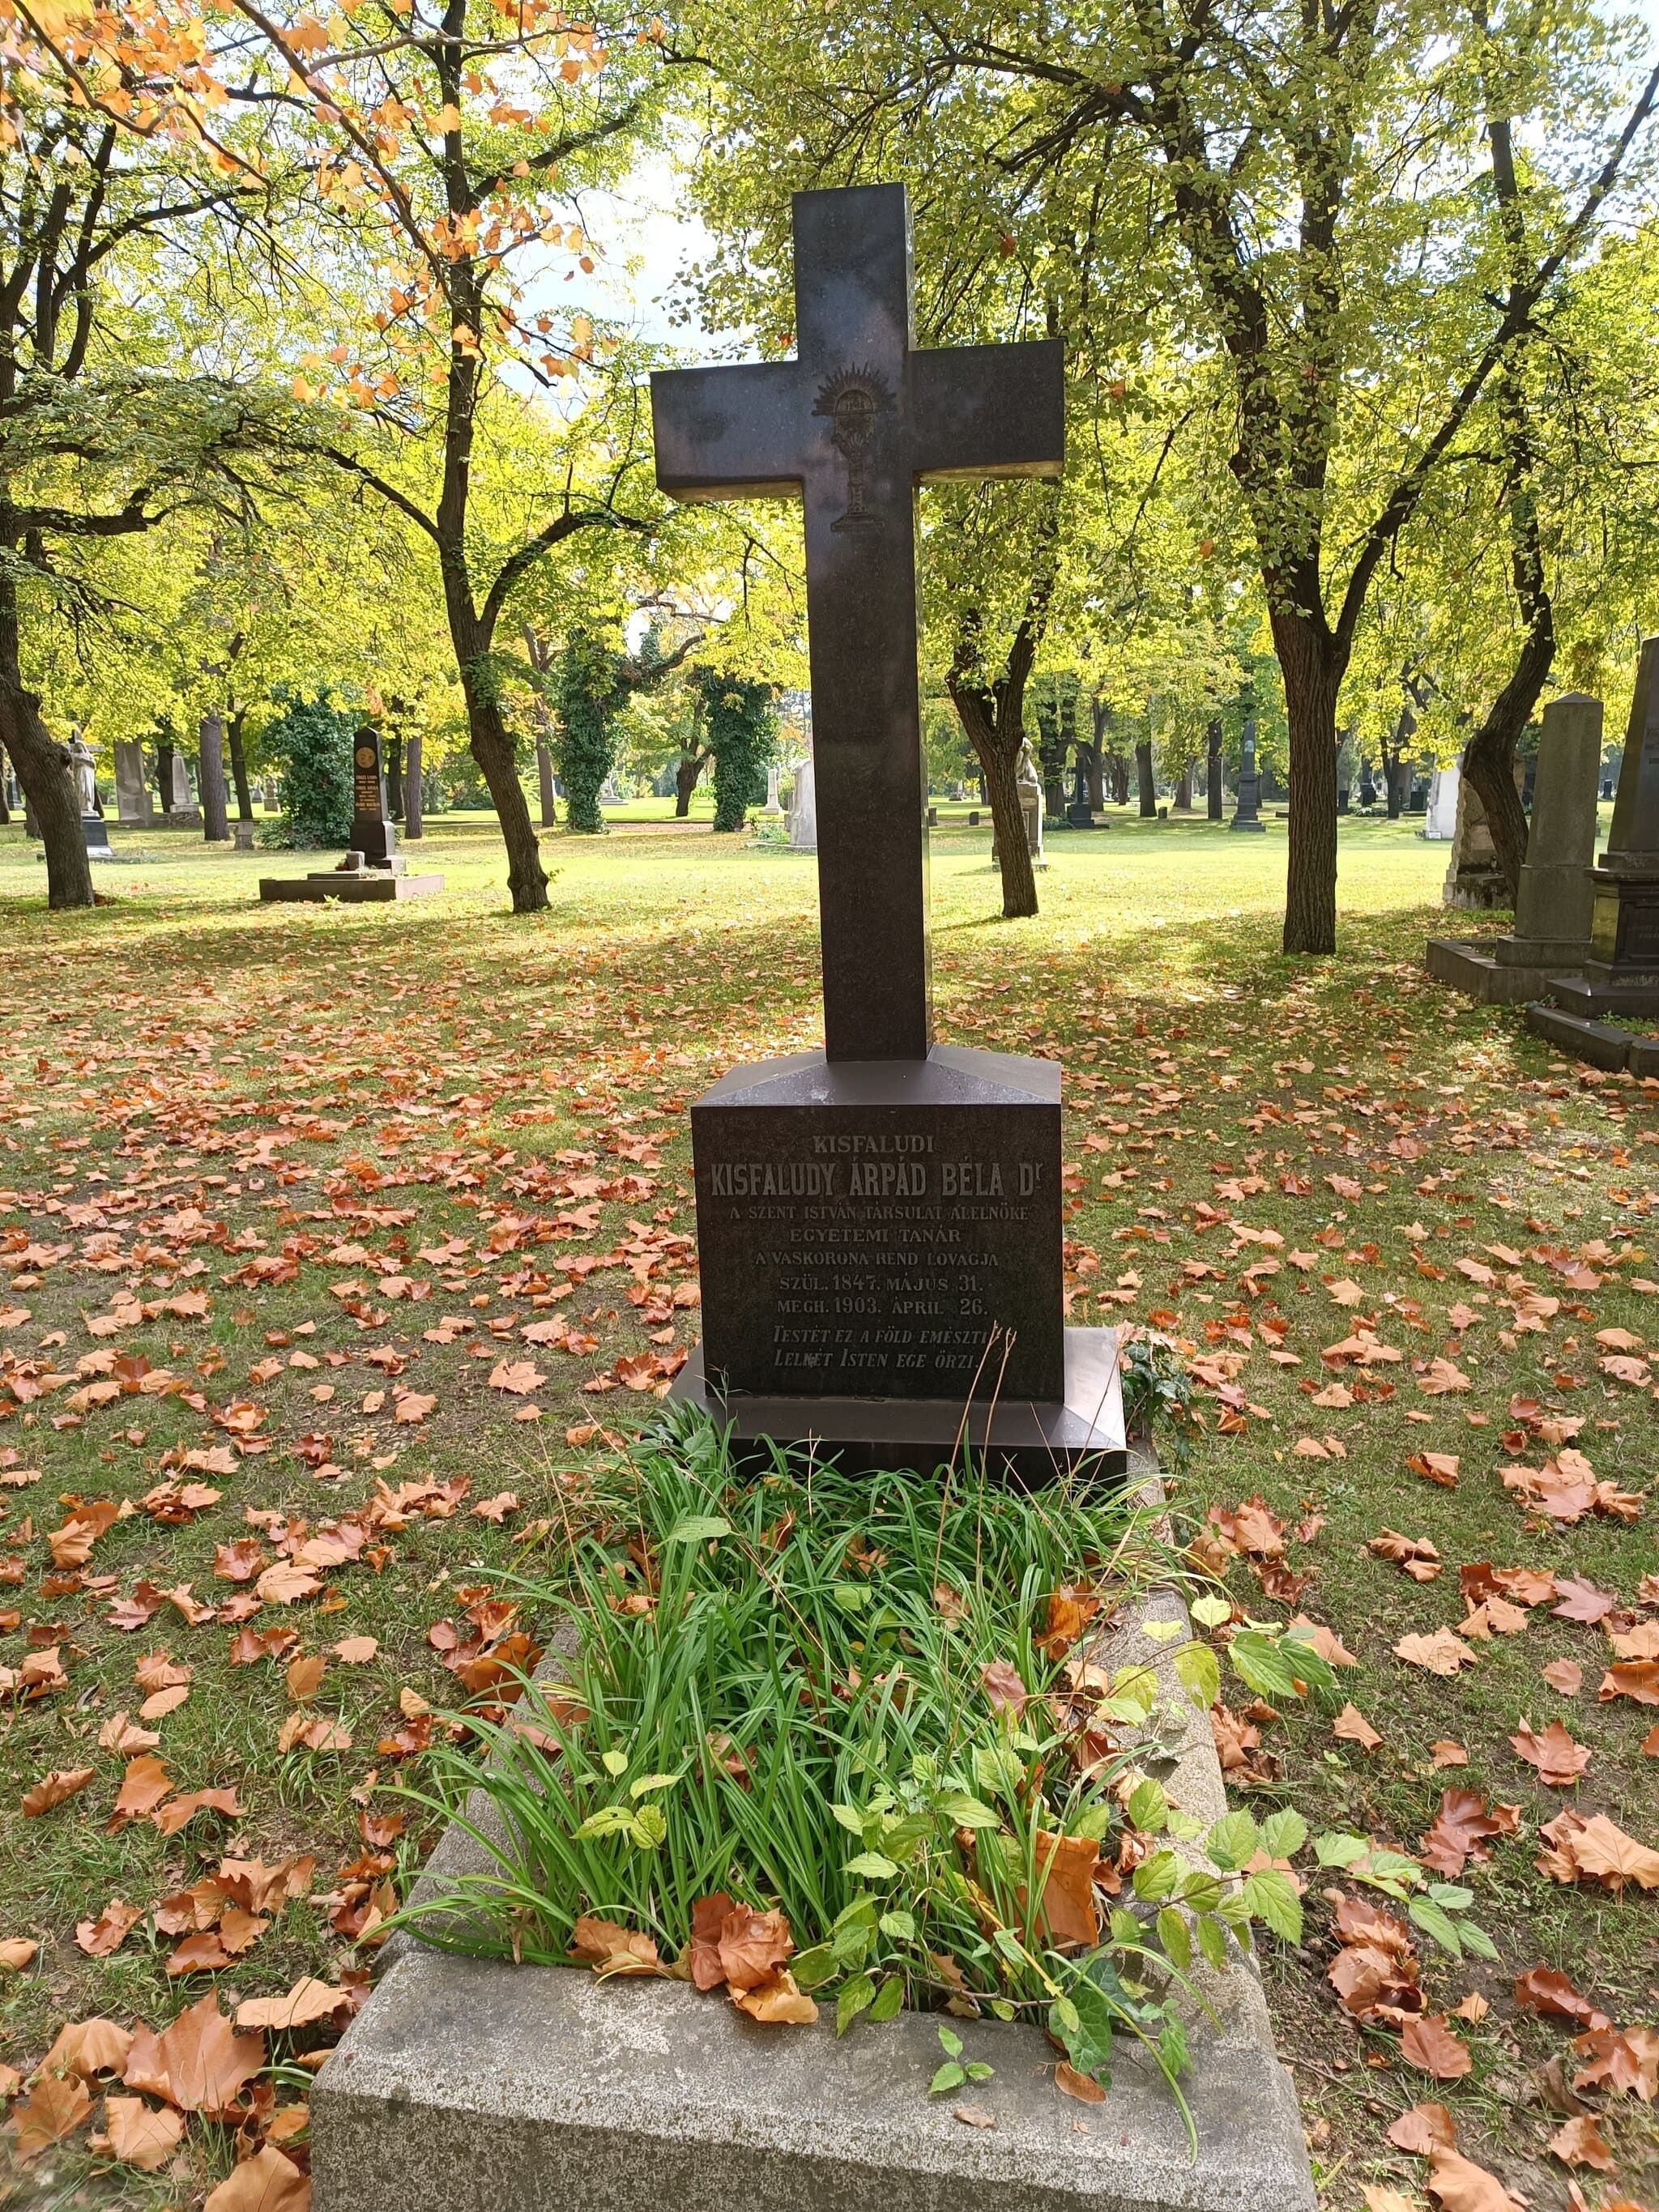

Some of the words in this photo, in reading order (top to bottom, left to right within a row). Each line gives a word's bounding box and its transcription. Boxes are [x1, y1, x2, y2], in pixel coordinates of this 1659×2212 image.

[812, 1135, 934, 1153] KISFALUDI
[710, 1162, 836, 1196] KISFALUDY
[849, 1156, 927, 1196] ÁRPÁD
[940, 1156, 1005, 1196] BÉLA
[730, 1206, 741, 1219] A
[748, 1205, 796, 1219] SZENT
[804, 1202, 856, 1219] ISTVÁN
[864, 1200, 943, 1220] TÁRSULAT
[790, 1229, 889, 1242] EGYETEMI
[899, 1224, 962, 1242] TANÁR
[755, 1252, 766, 1264] A
[770, 1251, 869, 1265] VASKORONA
[876, 1252, 919, 1266] REND
[927, 1252, 999, 1266] LOVAGJA
[779, 1274, 830, 1291] SZÜL.
[833, 1275, 881, 1291] 1847.
[886, 1272, 949, 1291] MÁJUS
[958, 1275, 983, 1292] 31.
[777, 1300, 830, 1314] MEGH.
[834, 1297, 881, 1314] 1903.
[892, 1296, 945, 1315] ÁPRIL
[960, 1298, 988, 1315] 26.
[774, 1324, 831, 1343] TESTÉT
[835, 1329, 853, 1343] EZ
[859, 1329, 869, 1343] A
[875, 1325, 912, 1343] FÖLD
[919, 1326, 987, 1345] EMÉSZTI
[840, 1348, 889, 1368] ISTEN
[896, 1353, 927, 1368] EGE
